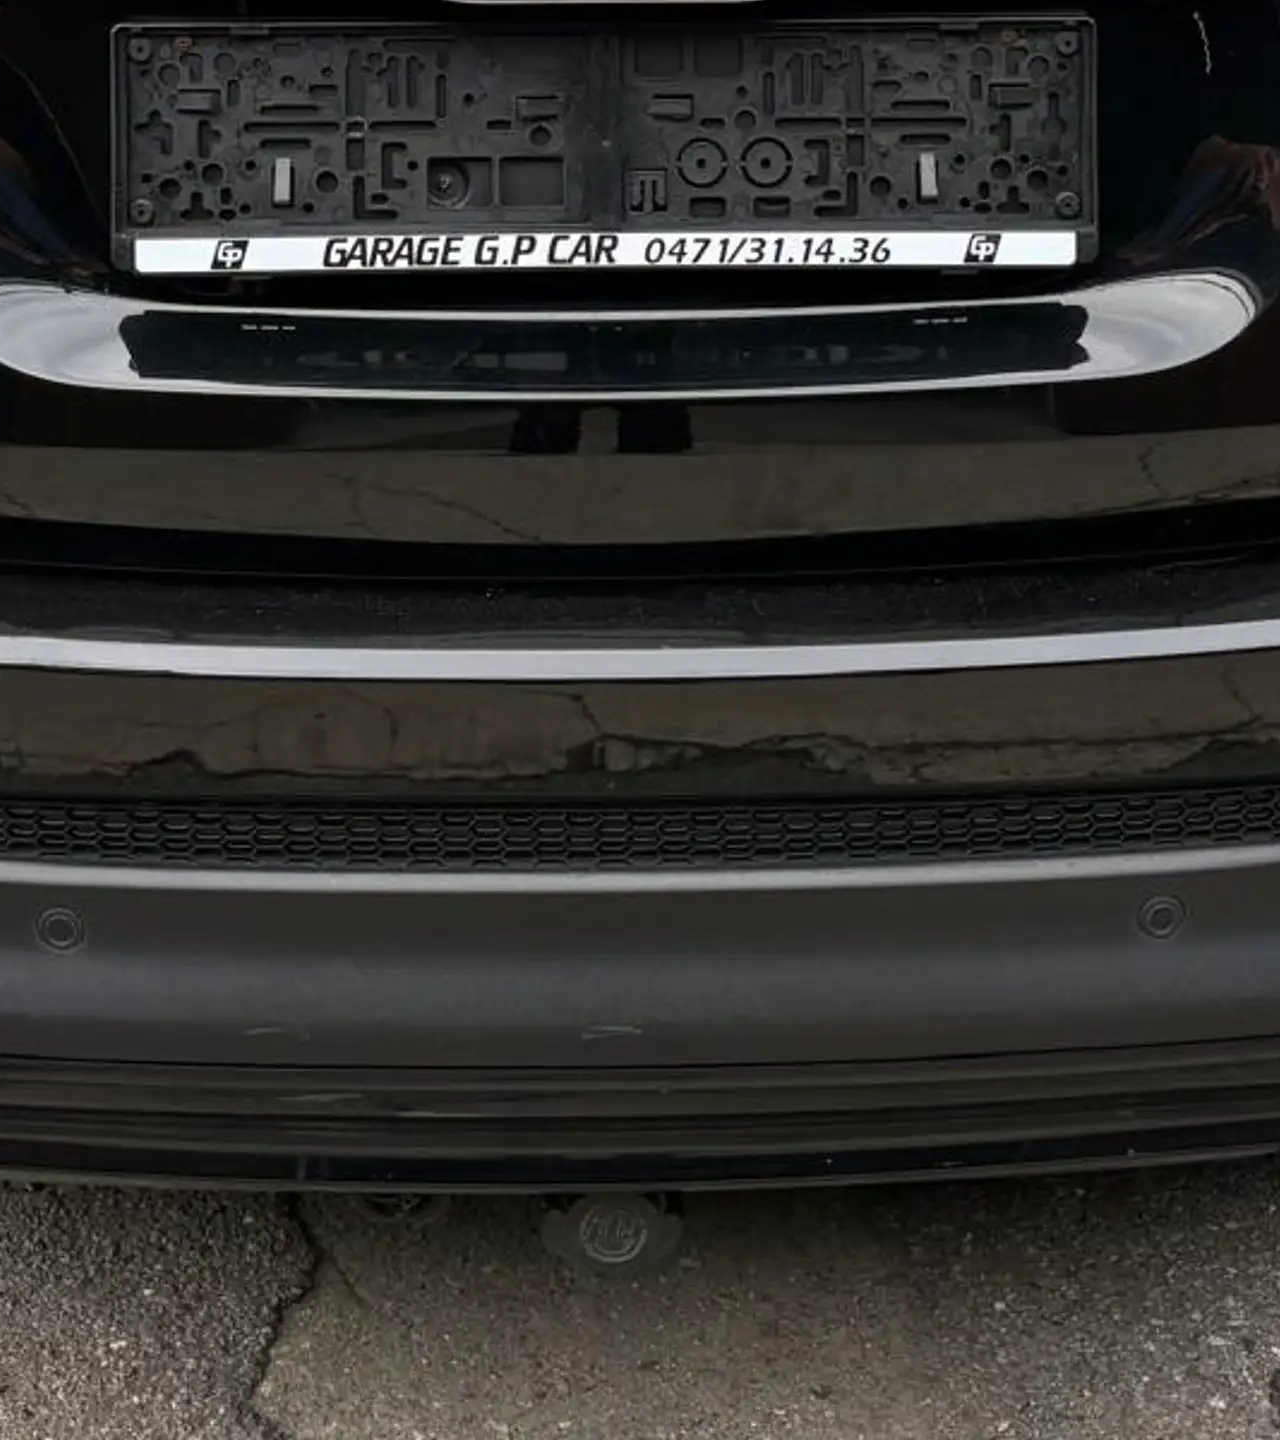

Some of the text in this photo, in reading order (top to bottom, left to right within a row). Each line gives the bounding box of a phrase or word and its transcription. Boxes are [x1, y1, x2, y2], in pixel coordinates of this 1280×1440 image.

[323, 234, 891, 268] GARAGE G.P CAR 0471/31.14.36
